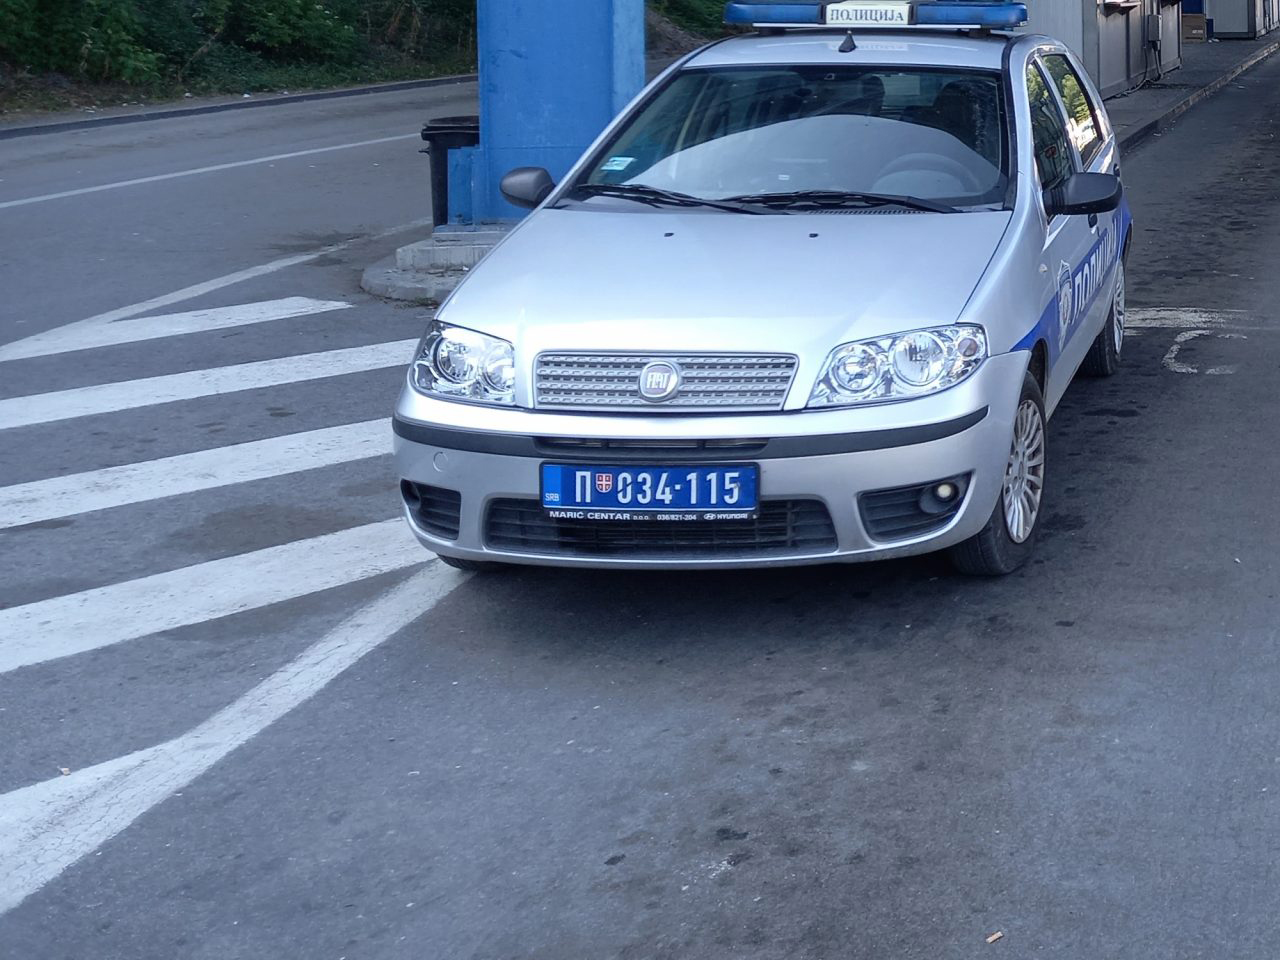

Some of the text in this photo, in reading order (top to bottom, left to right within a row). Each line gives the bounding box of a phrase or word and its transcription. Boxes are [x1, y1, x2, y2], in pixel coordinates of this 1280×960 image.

[831, 9, 904, 22] ПОЛИЦИЈА
[646, 372, 670, 388] FIAT
[575, 471, 591, 503] П
[545, 493, 560, 502] SRB
[549, 510, 585, 520] MARIĆ
[587, 512, 631, 521] CENTAR
